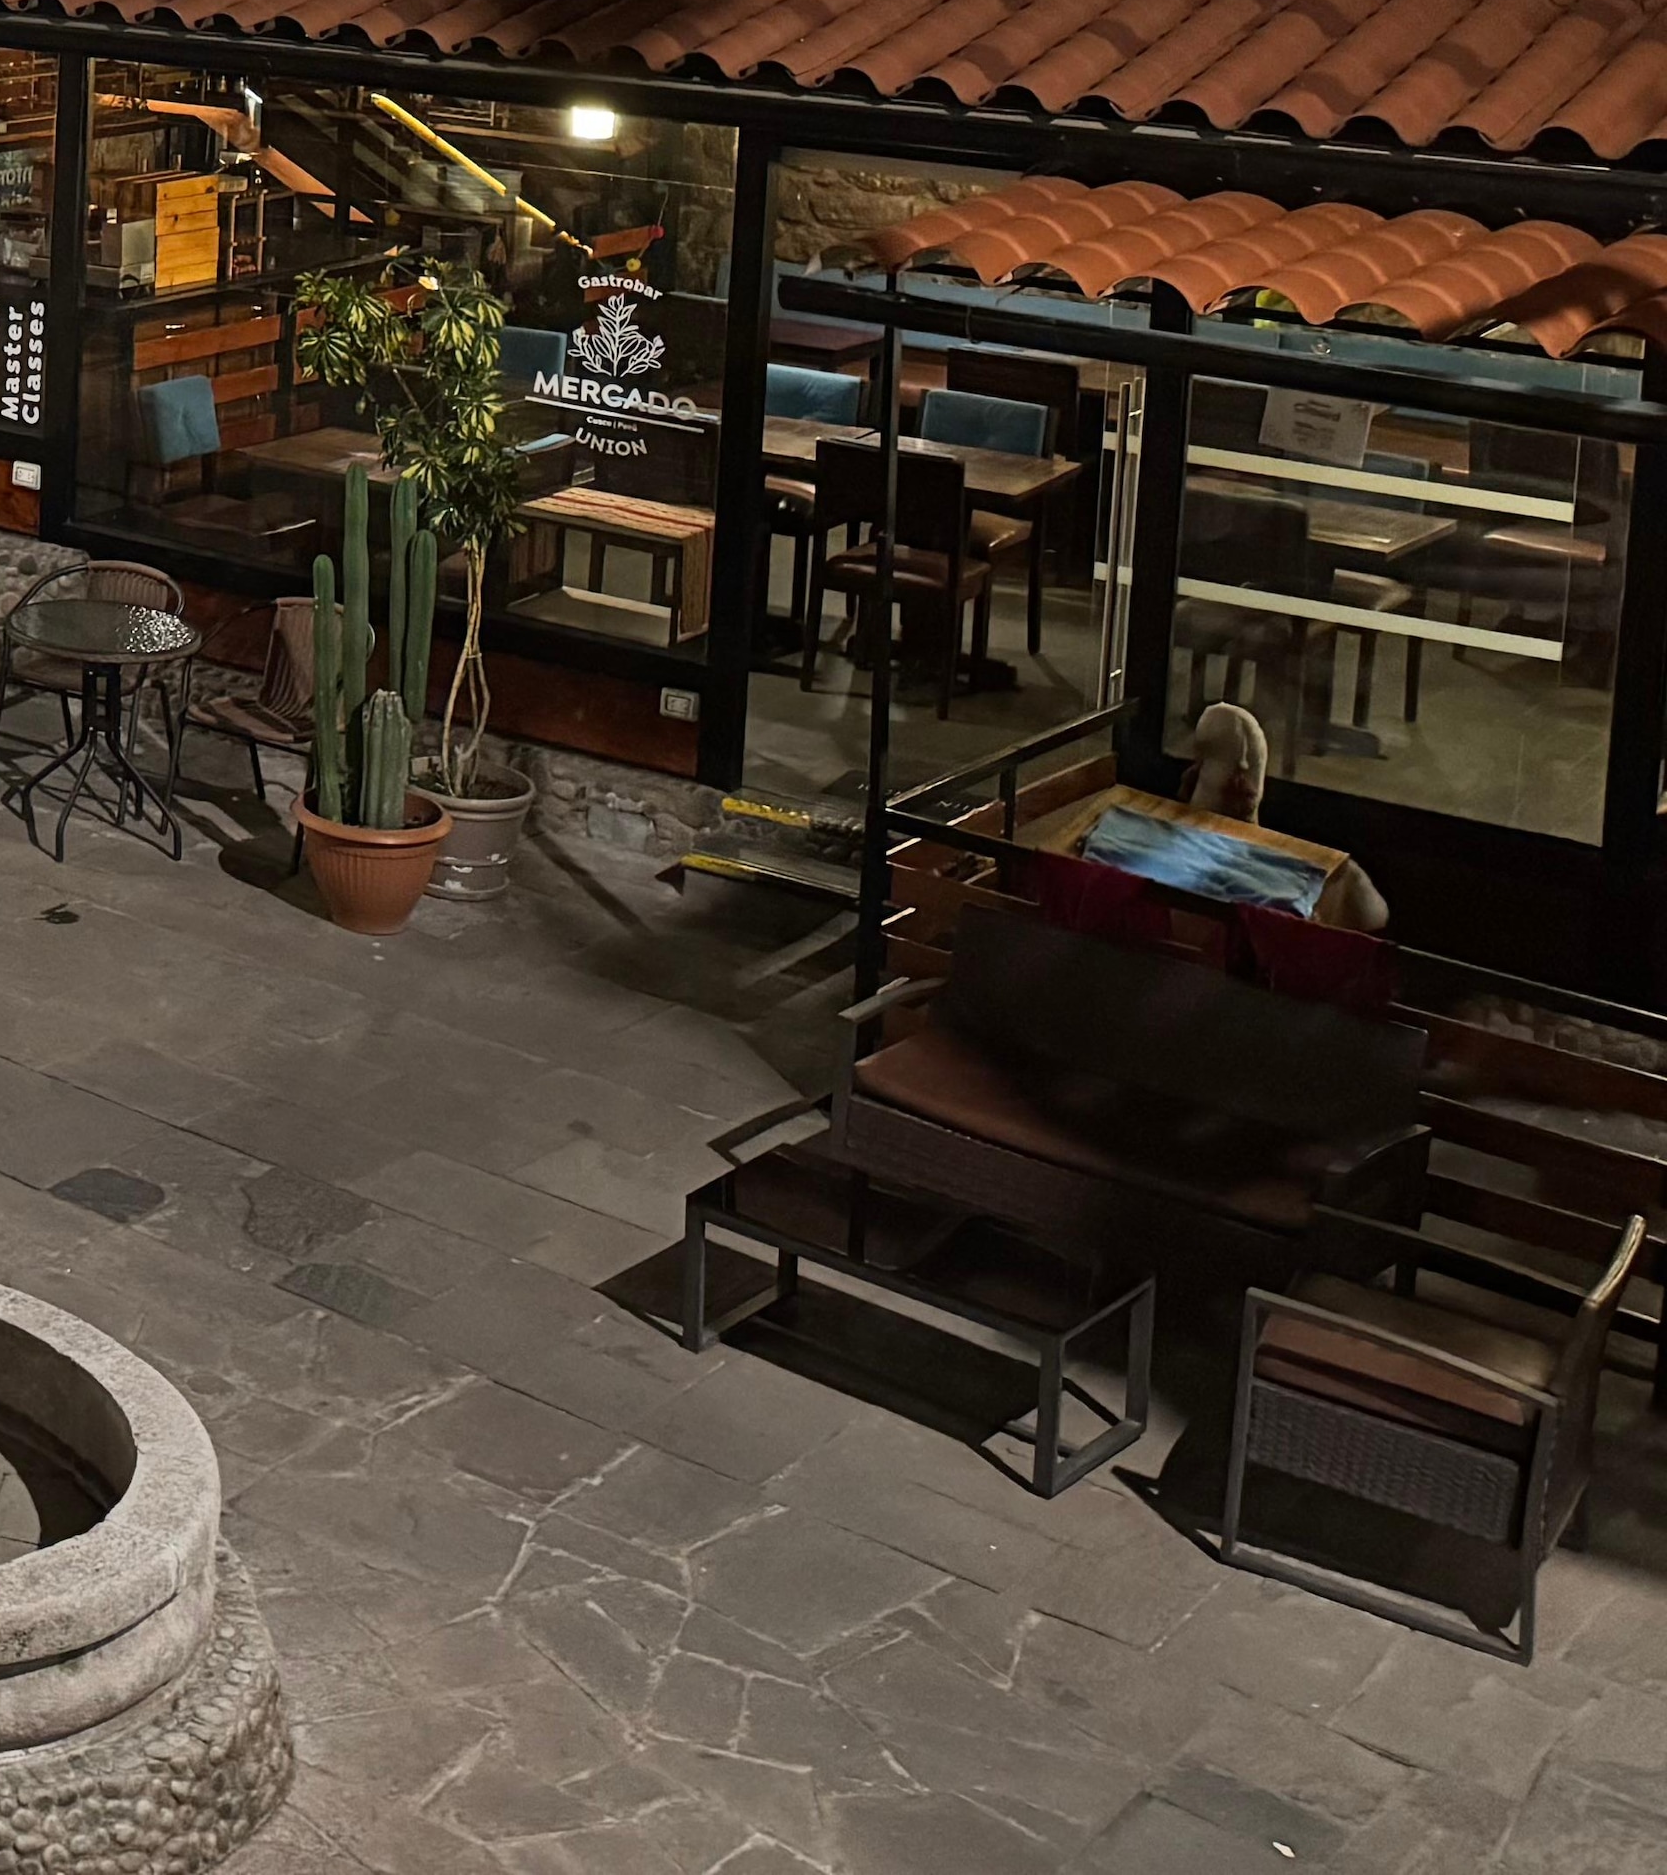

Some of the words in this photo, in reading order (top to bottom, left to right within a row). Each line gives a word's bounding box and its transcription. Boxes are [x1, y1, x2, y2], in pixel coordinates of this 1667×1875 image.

[577, 274, 664, 301] Gastrobar
[0, 305, 25, 422] Master
[21, 300, 46, 425] Classes
[532, 370, 698, 421] MERCADO
[575, 426, 649, 457] UNION
